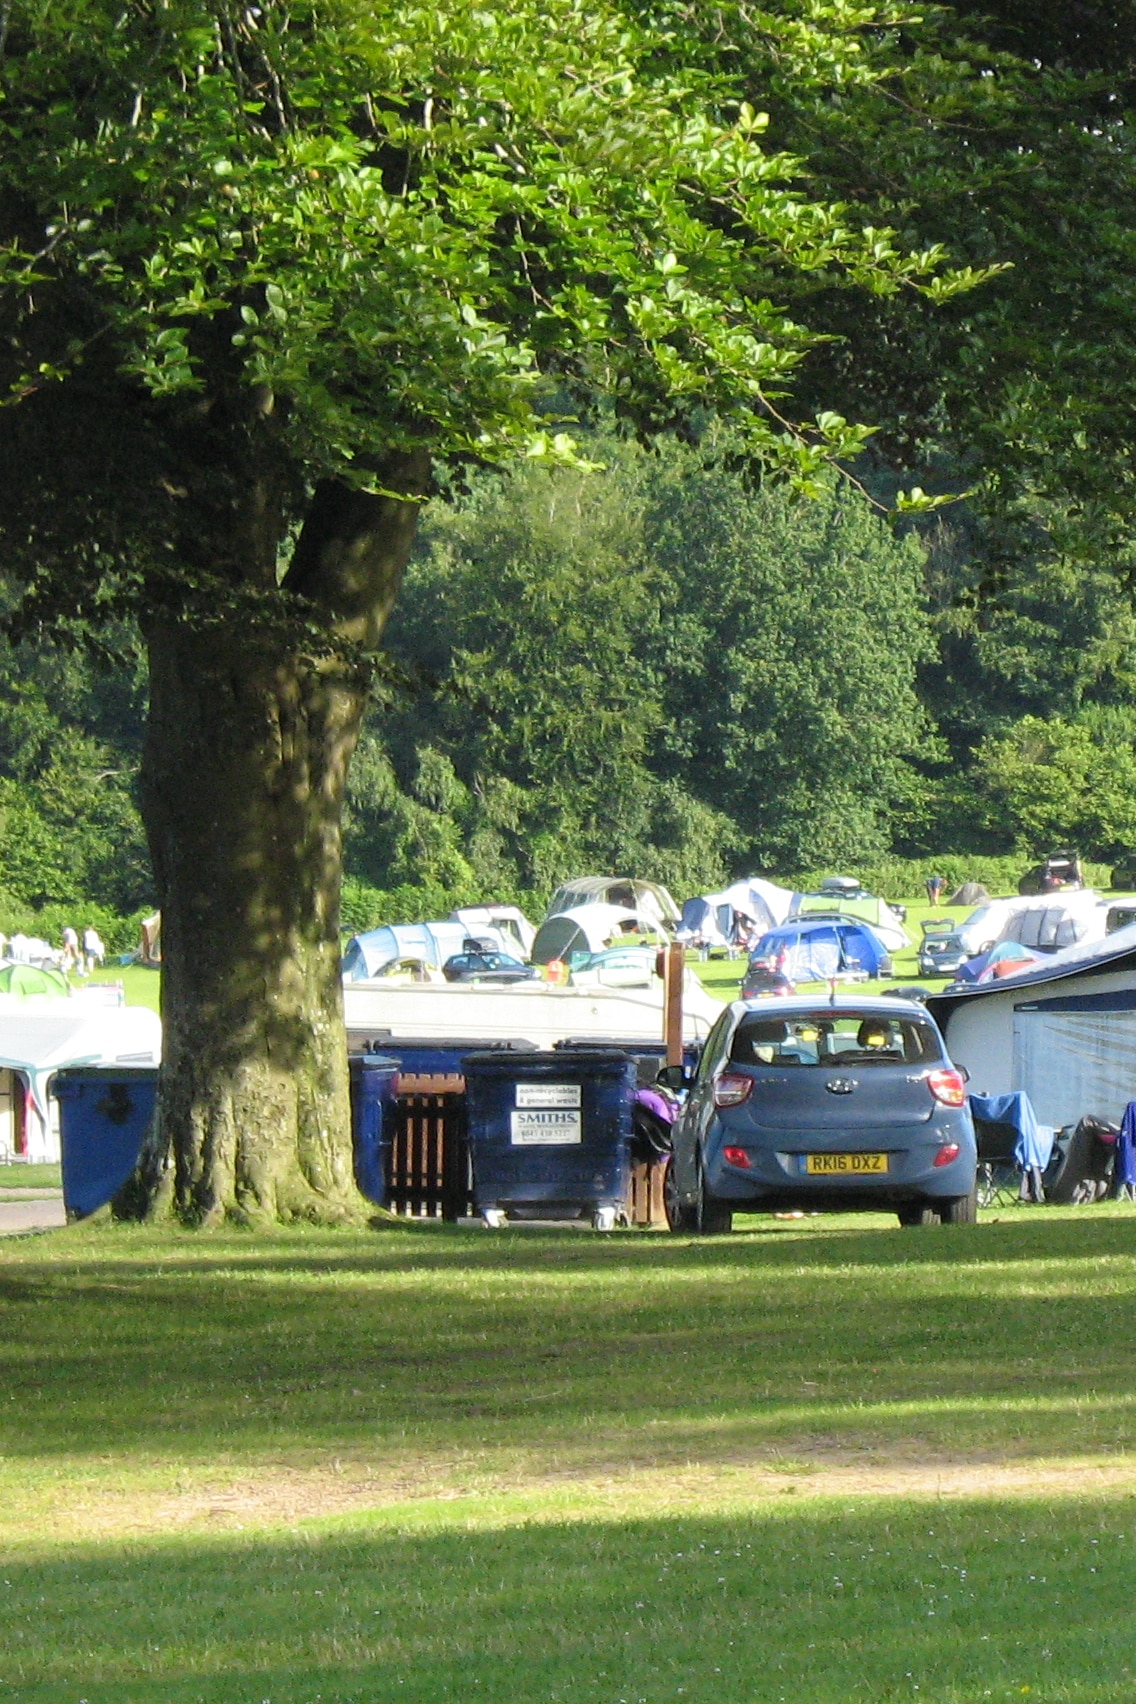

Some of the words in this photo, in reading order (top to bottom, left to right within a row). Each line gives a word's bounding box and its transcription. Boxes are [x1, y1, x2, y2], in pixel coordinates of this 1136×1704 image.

[527, 1097, 555, 1105] general
[517, 1113, 577, 1123] SMITHS
[812, 1156, 847, 1171] RK16
[851, 1156, 881, 1170] DXZ
